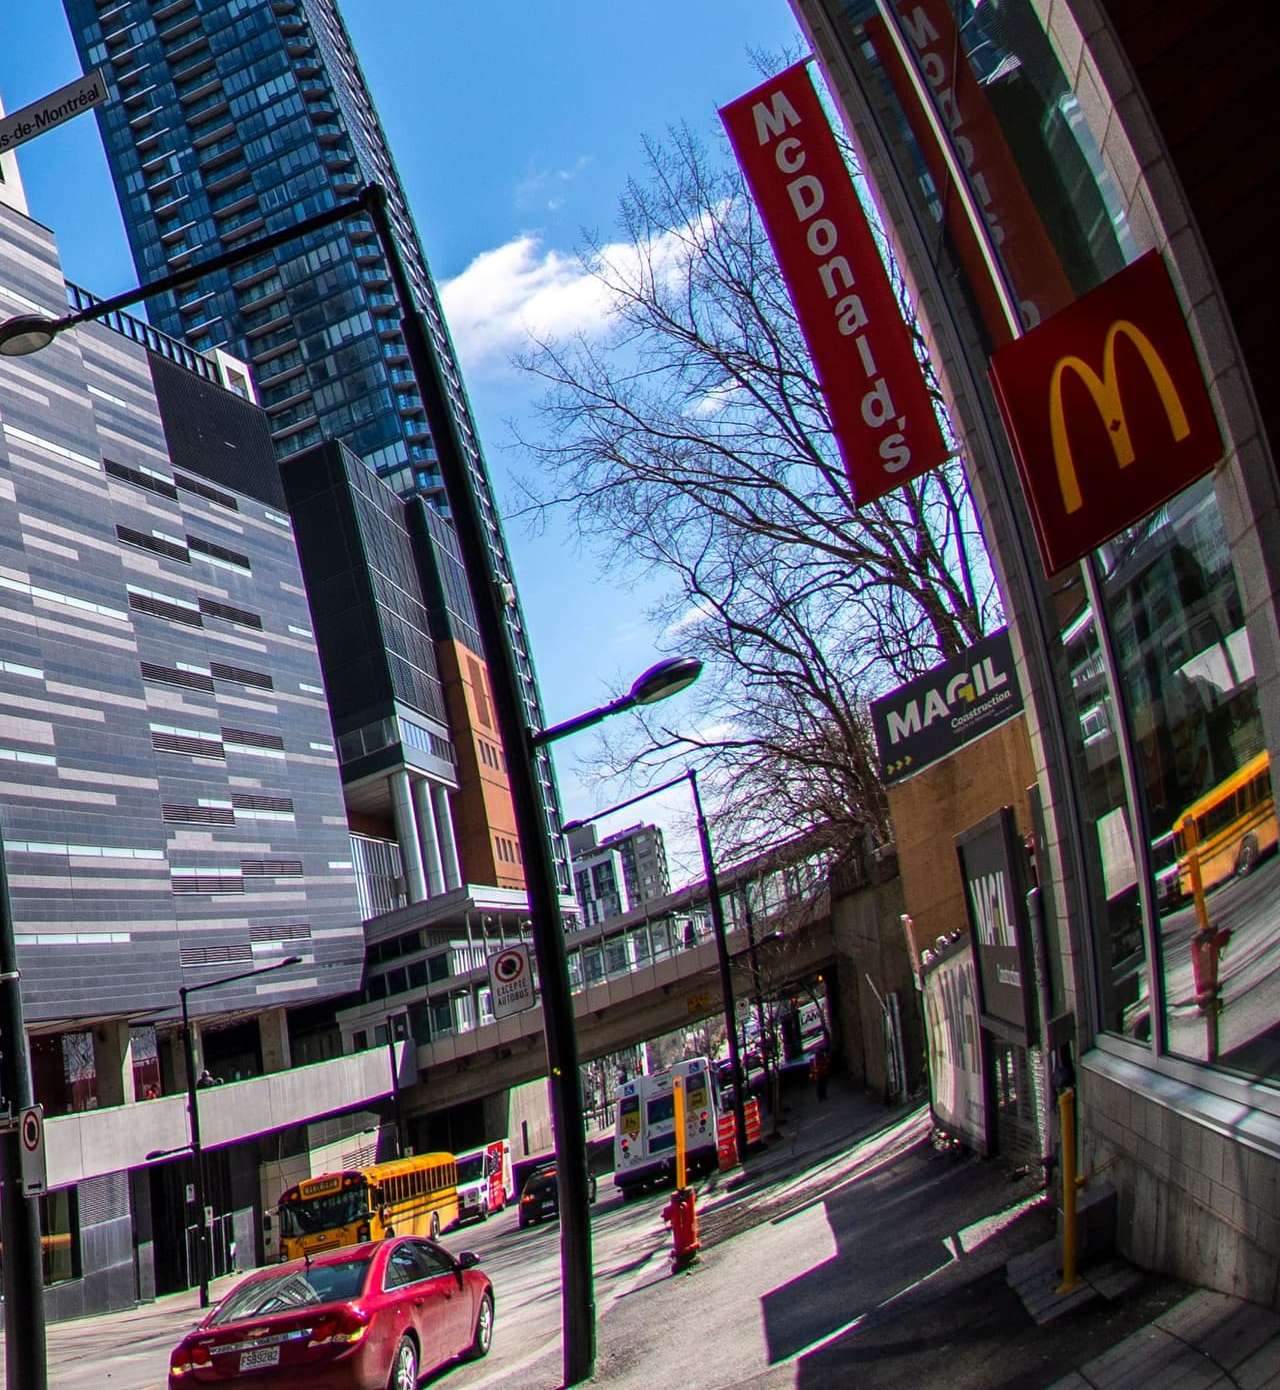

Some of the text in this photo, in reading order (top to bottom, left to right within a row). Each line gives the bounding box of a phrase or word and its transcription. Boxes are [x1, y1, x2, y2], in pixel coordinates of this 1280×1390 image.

[752, 90, 912, 474] McDonald's
[886, 656, 1008, 746] MAGIL
[951, 689, 1012, 728] Construction
[496, 990, 529, 1007] AUTOBUS
